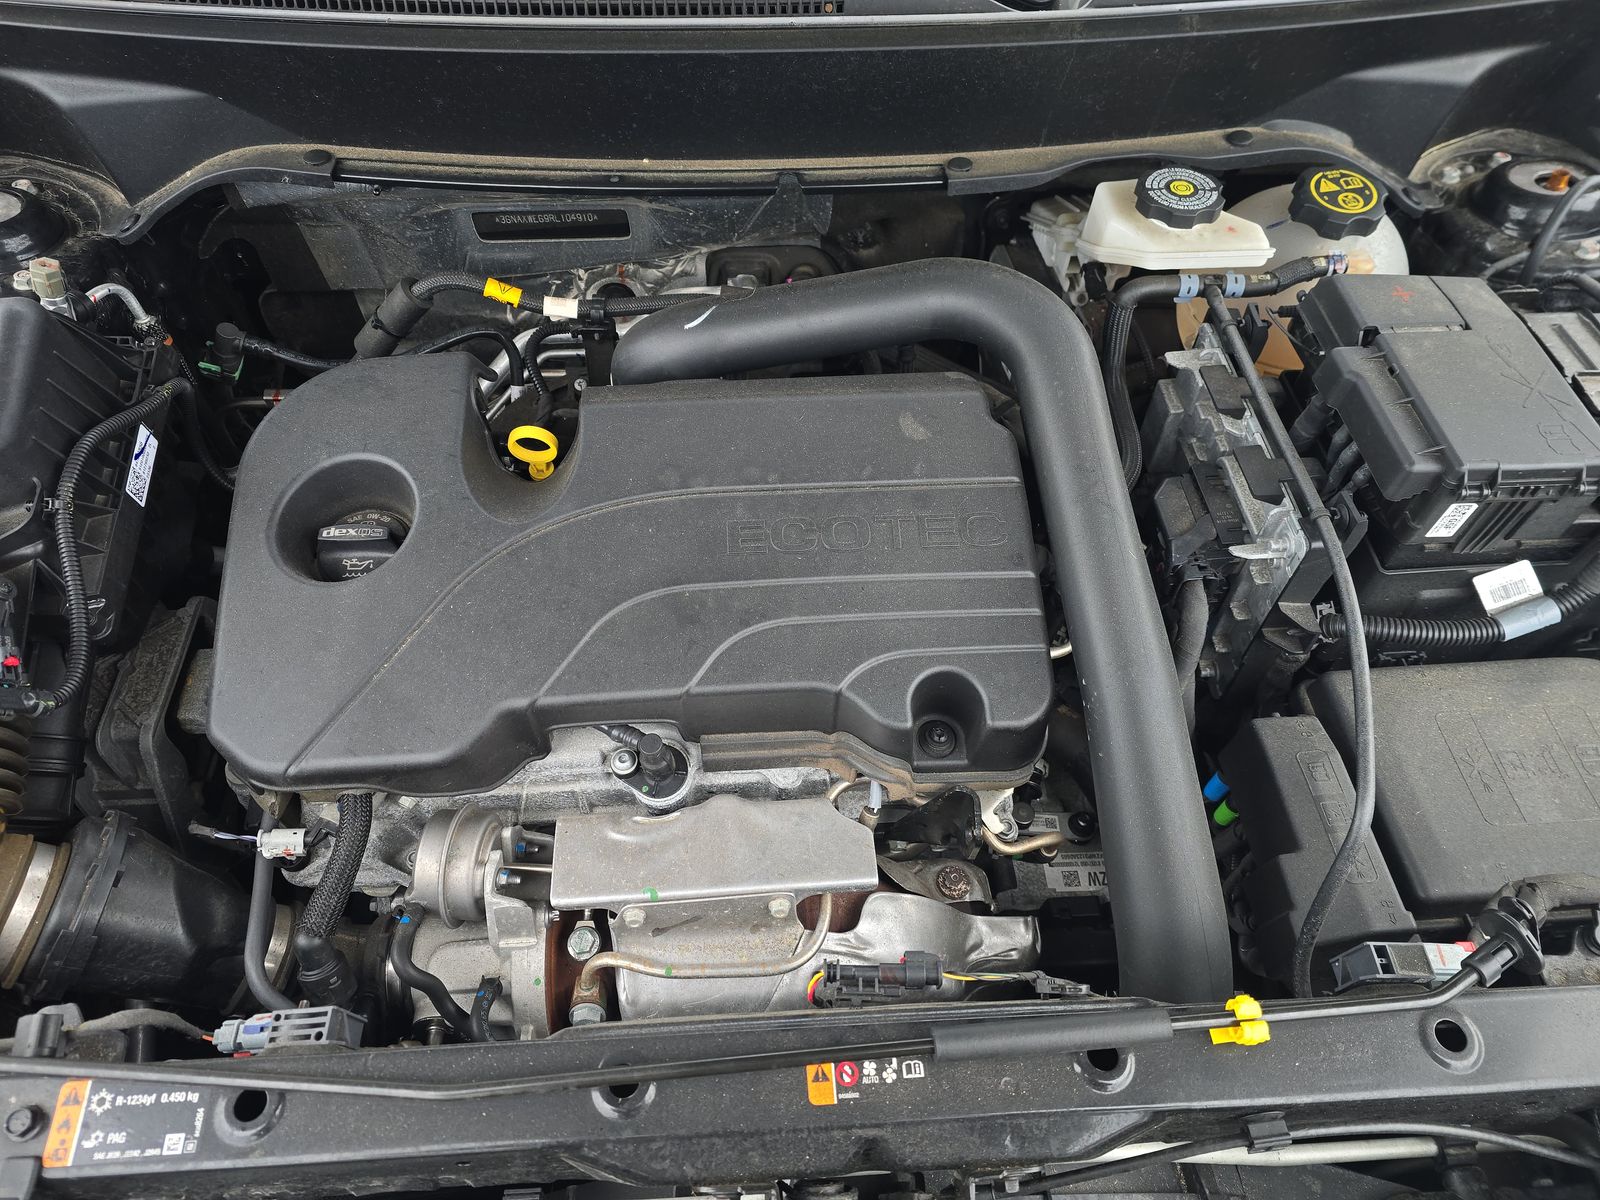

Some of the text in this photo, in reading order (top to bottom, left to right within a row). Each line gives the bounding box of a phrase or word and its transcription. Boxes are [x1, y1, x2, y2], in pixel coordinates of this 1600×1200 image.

[347, 514, 362, 524] SAE
[726, 510, 1009, 555] ECOTEC
[862, 1075, 879, 1084] AUTO
[115, 1091, 200, 1107] R-1234yf 0.450 kg
[106, 1132, 127, 1144] PAG
